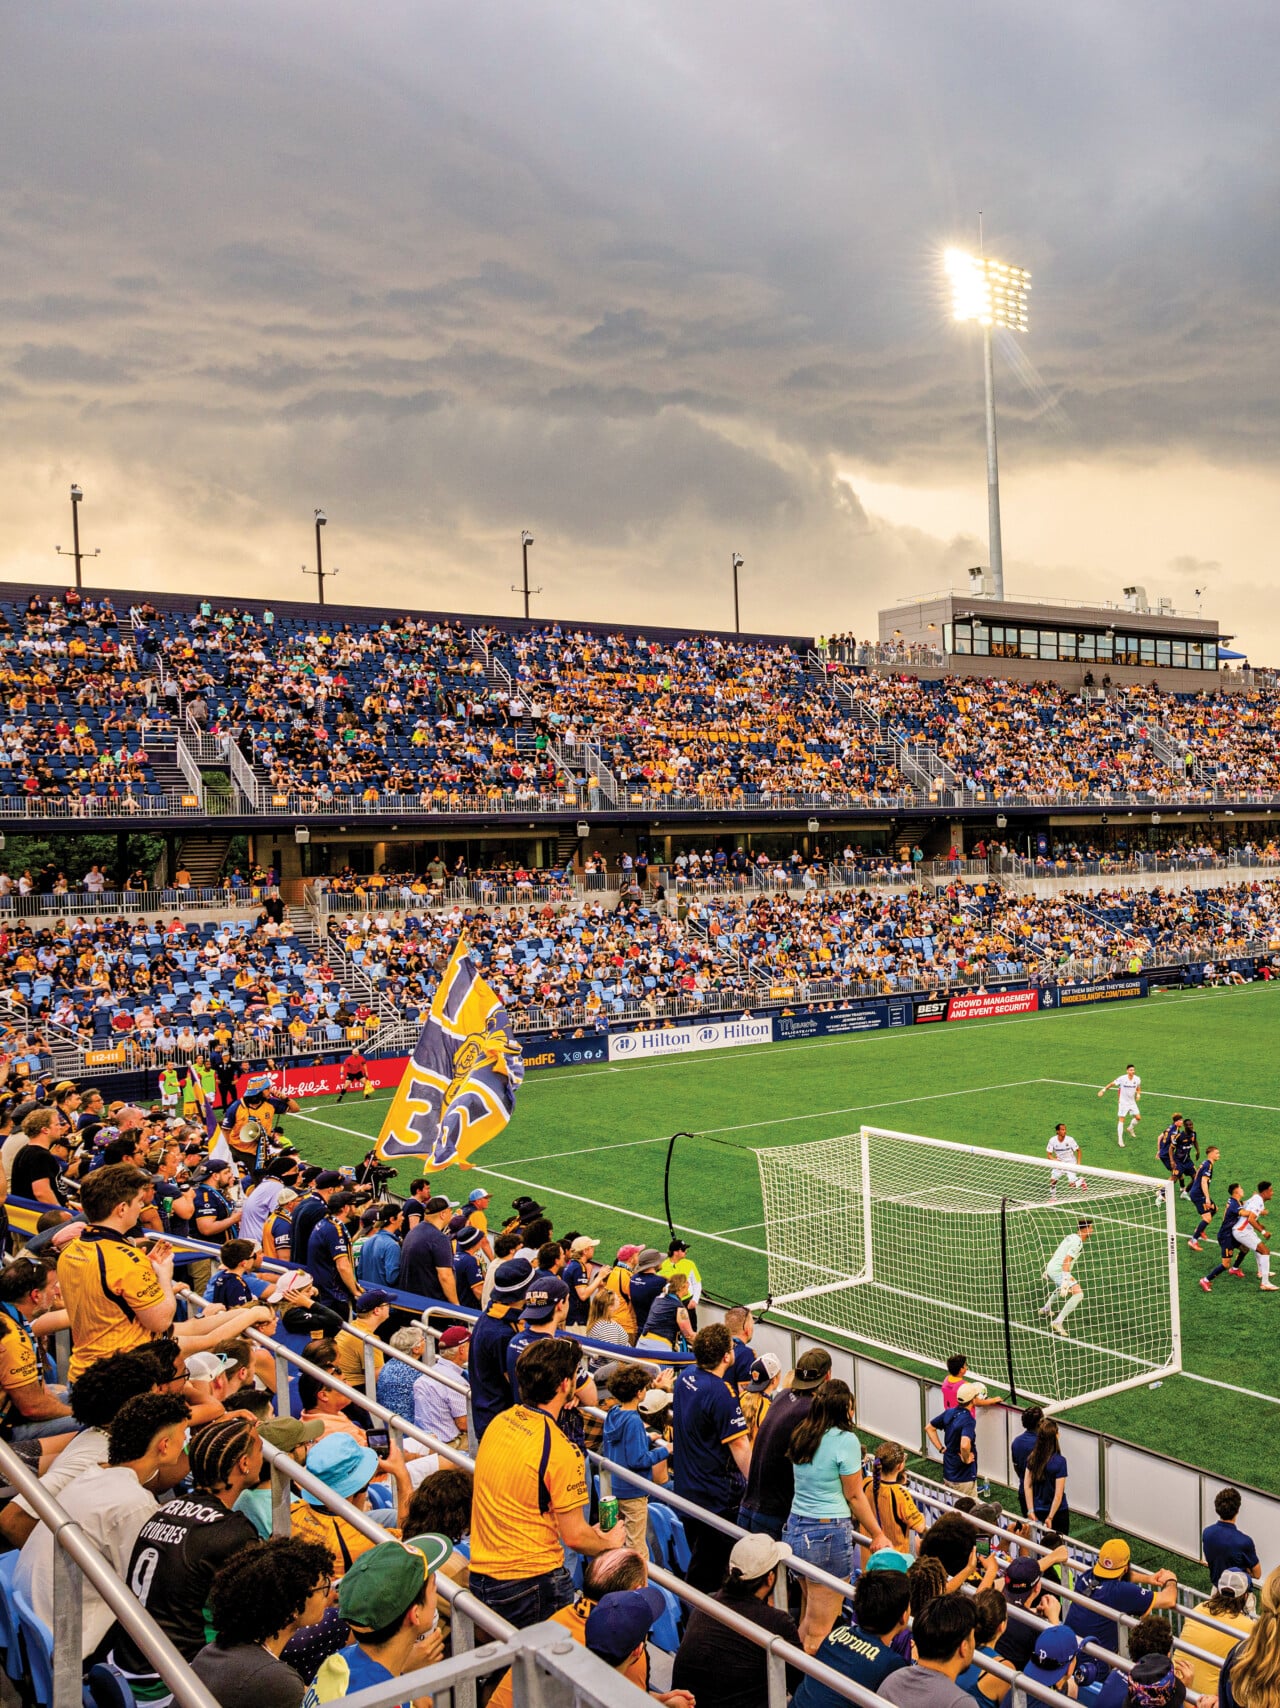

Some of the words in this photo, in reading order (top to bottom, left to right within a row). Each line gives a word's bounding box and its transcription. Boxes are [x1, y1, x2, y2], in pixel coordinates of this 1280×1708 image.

[1085, 985, 1106, 993] BEFORE
[918, 1002, 947, 1013] BEST
[952, 998, 981, 1008] CROWD
[983, 992, 1035, 1004] MANAGEMENT
[950, 1008, 967, 1018] AND
[968, 1005, 993, 1016] EVENT
[994, 1001, 1031, 1013] SECURITY
[723, 1024, 769, 1038] Hilton
[642, 1033, 690, 1048] Hilton
[92, 1053, 118, 1062] 112-111
[522, 1052, 556, 1067] andFC
[180, 1501, 225, 1522] BOCK
[131, 1547, 160, 1607] 9
[828, 1625, 881, 1662] Corona
